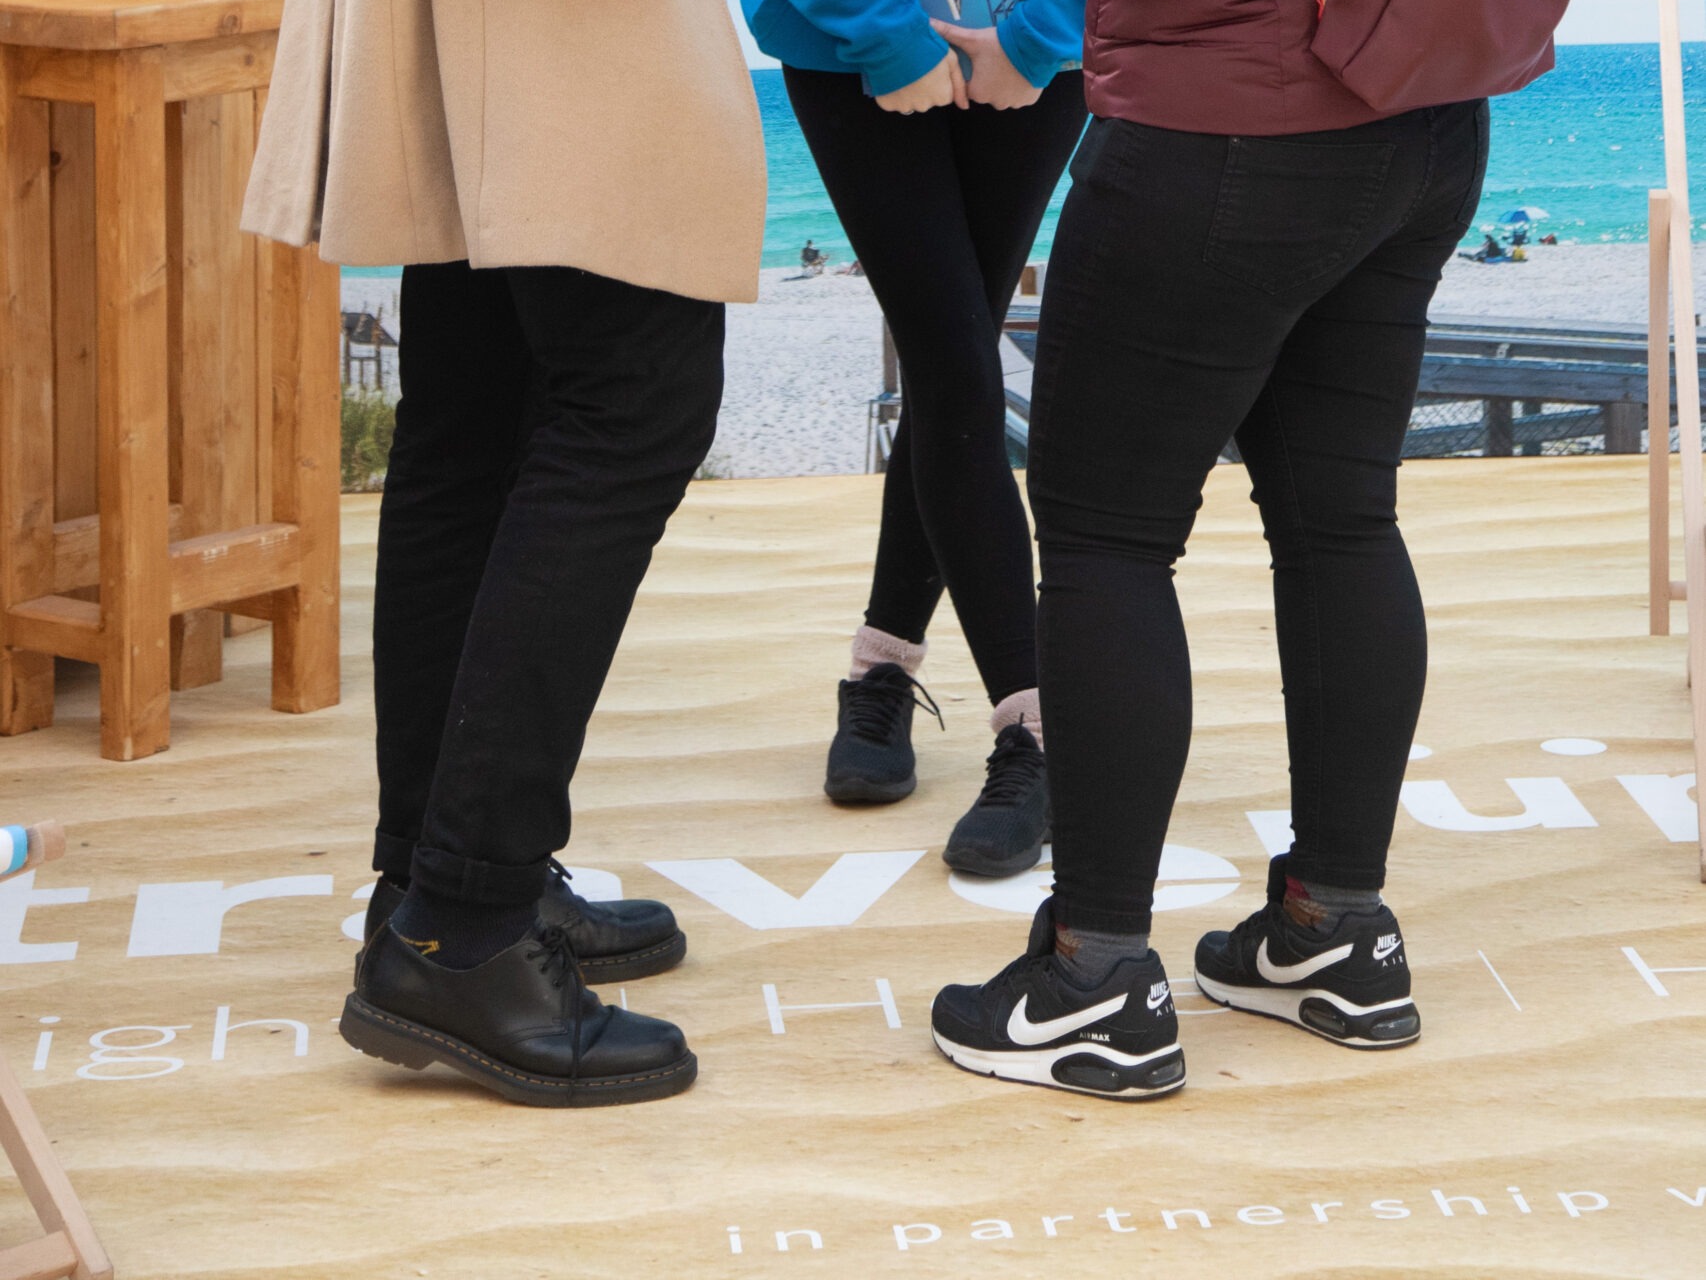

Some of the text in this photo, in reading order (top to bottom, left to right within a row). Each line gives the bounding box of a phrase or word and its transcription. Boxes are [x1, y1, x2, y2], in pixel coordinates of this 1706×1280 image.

[1376, 933, 1397, 951] NIKE
[1150, 981, 1168, 1000] NIKE
[727, 1186, 1610, 1254] in partnership
